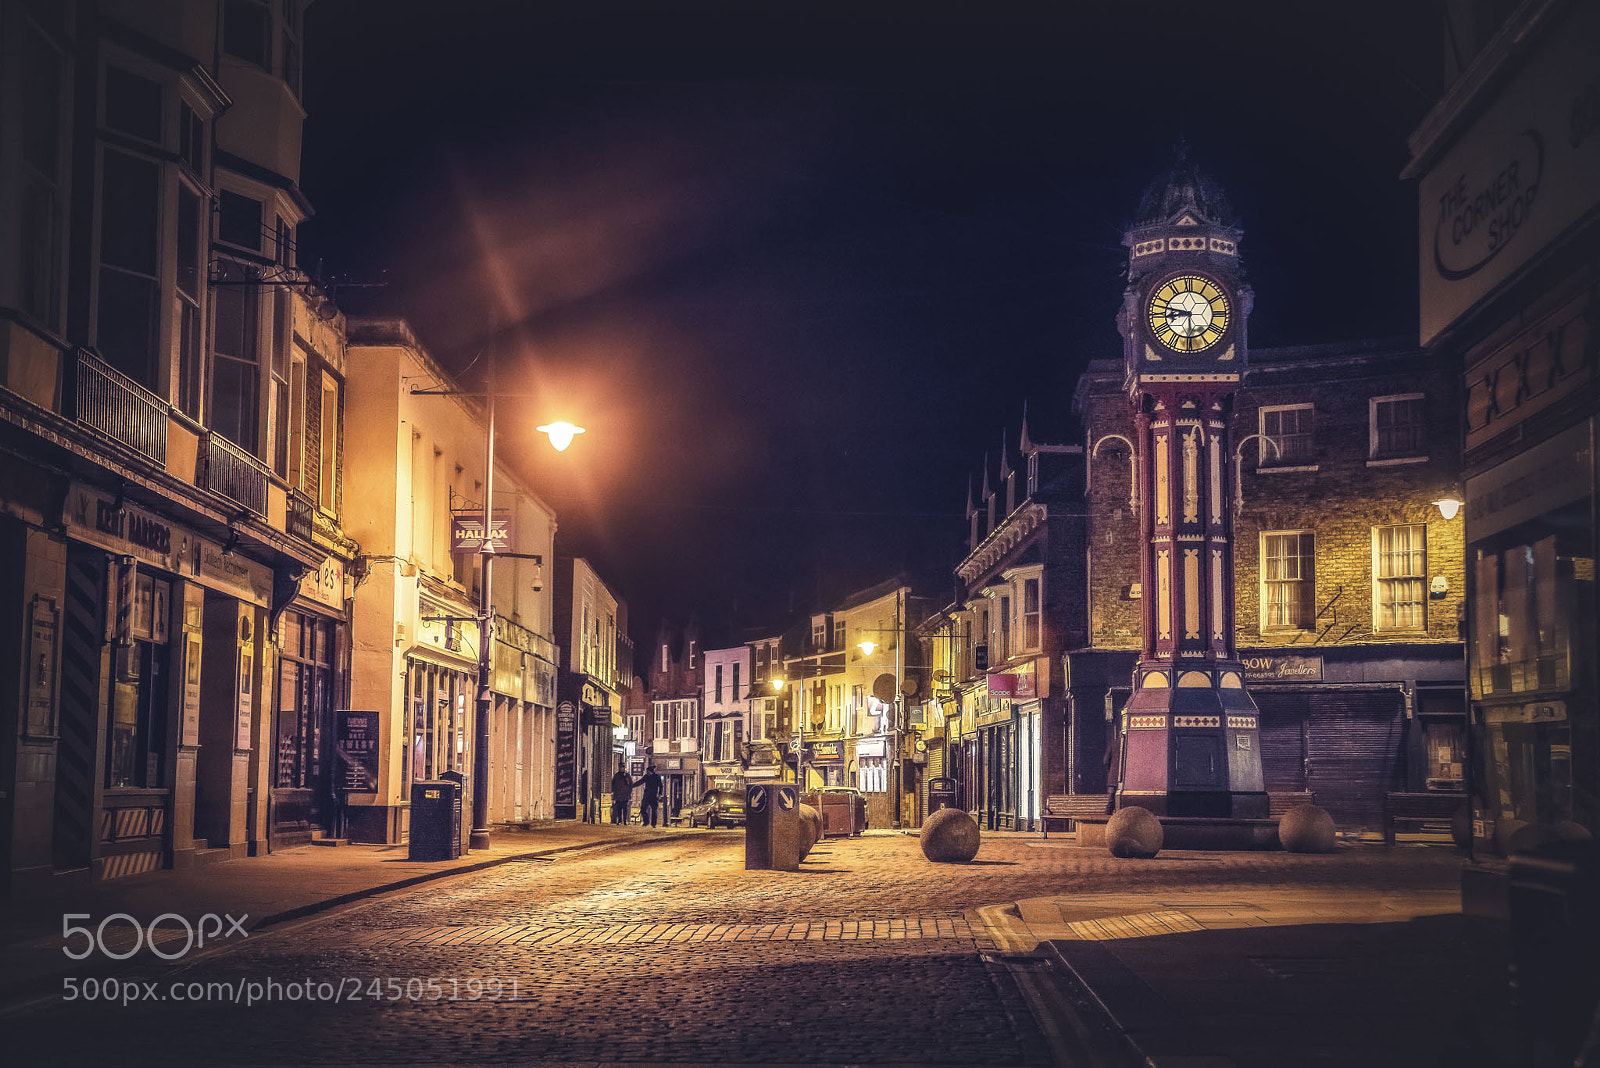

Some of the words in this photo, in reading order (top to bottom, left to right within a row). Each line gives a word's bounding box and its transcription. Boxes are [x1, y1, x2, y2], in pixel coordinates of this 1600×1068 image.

[1439, 173, 1467, 223] THE
[1453, 160, 1518, 245] CORNER
[1488, 184, 1538, 249] SHOP
[455, 530, 508, 539] HALIAX
[1277, 661, 1317, 678] Jewellers
